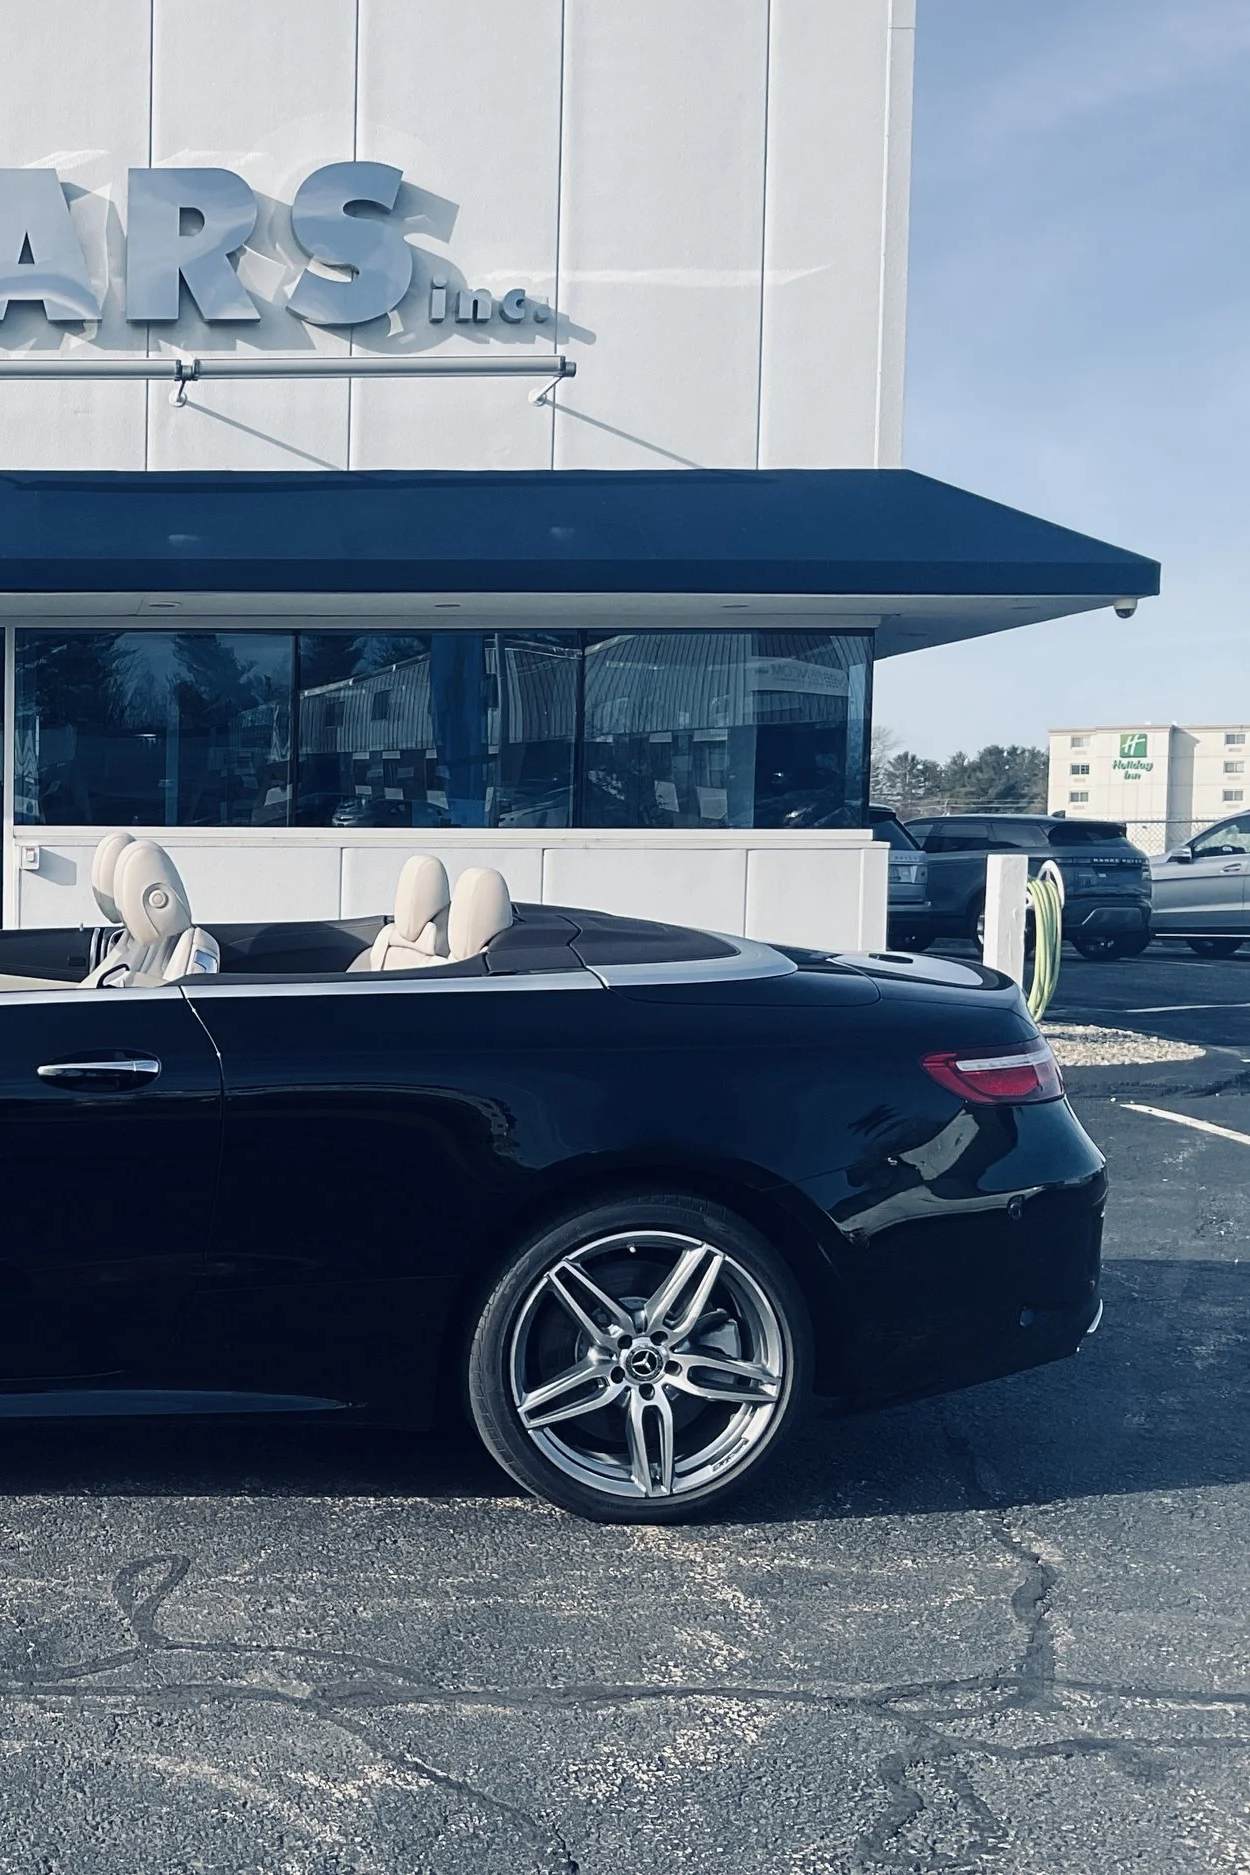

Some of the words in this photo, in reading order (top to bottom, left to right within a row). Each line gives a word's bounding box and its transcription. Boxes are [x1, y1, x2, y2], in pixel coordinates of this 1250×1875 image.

[430, 273, 551, 324] inc.
[1112, 760, 1154, 772] Holiday
[1124, 770, 1141, 780] Inn
